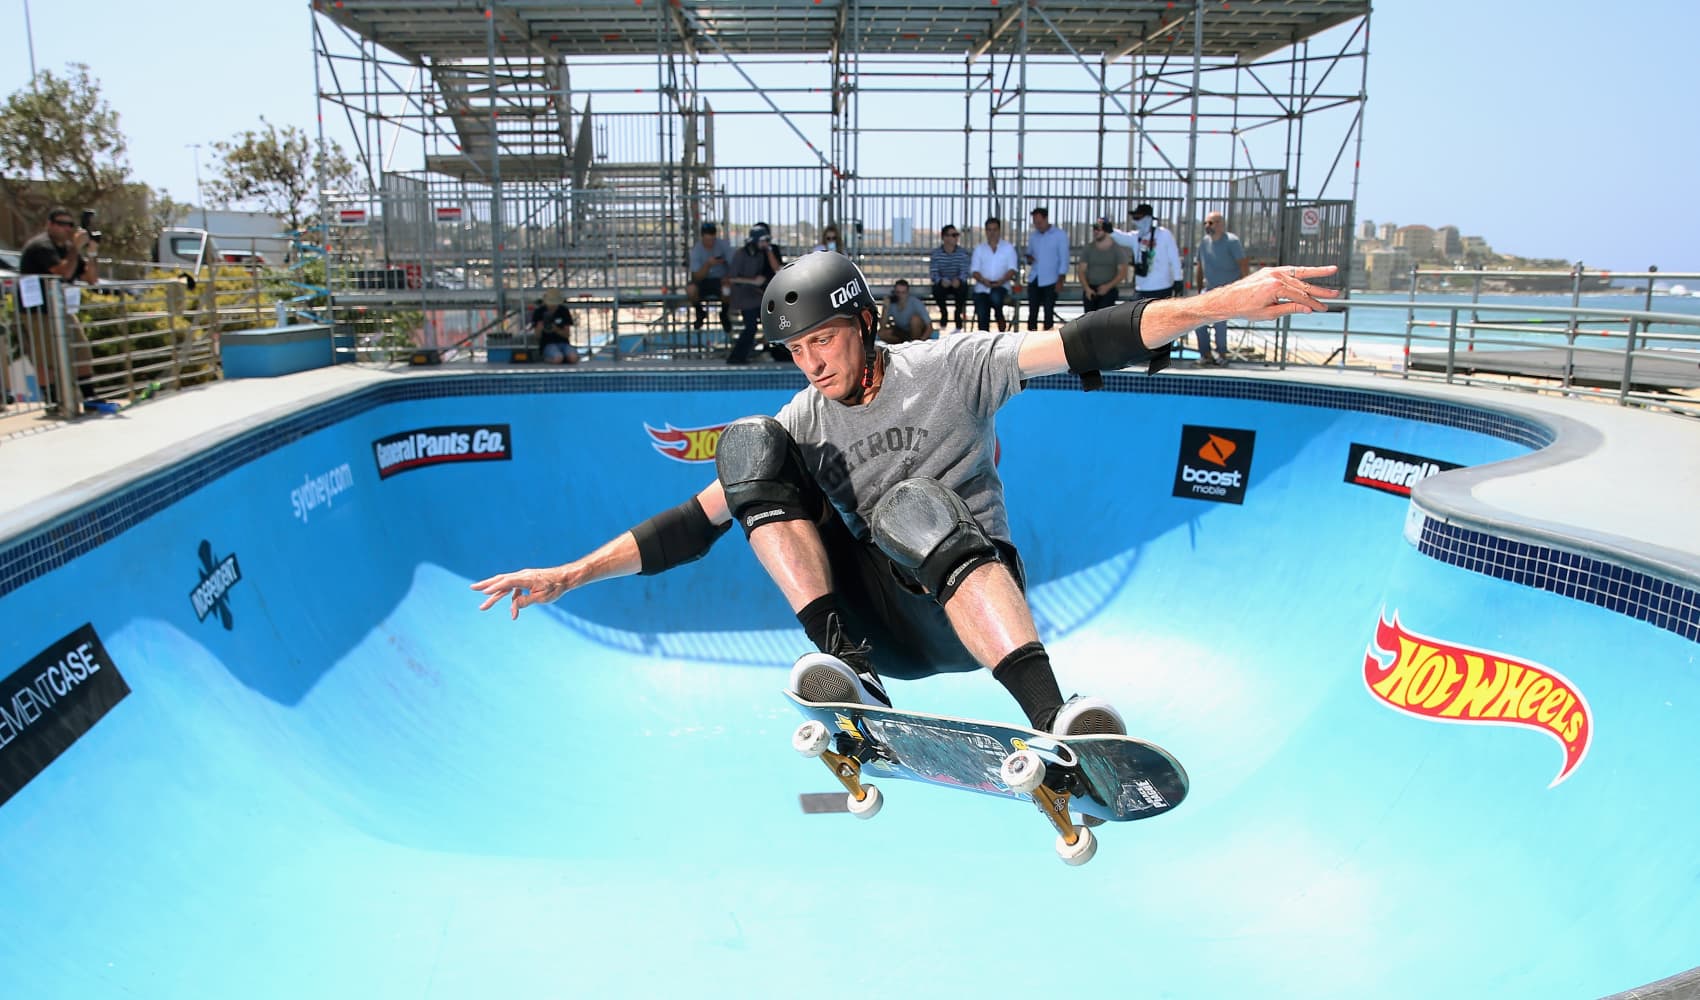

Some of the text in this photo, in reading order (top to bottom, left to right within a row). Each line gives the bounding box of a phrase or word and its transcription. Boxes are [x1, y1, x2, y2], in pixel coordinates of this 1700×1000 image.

[376, 429, 505, 469] General Pants Co.
[683, 429, 722, 460] HO
[1182, 465, 1242, 488] boost
[1357, 451, 1429, 488] General
[291, 463, 354, 523] sydney.com
[1192, 484, 1227, 496] mobile
